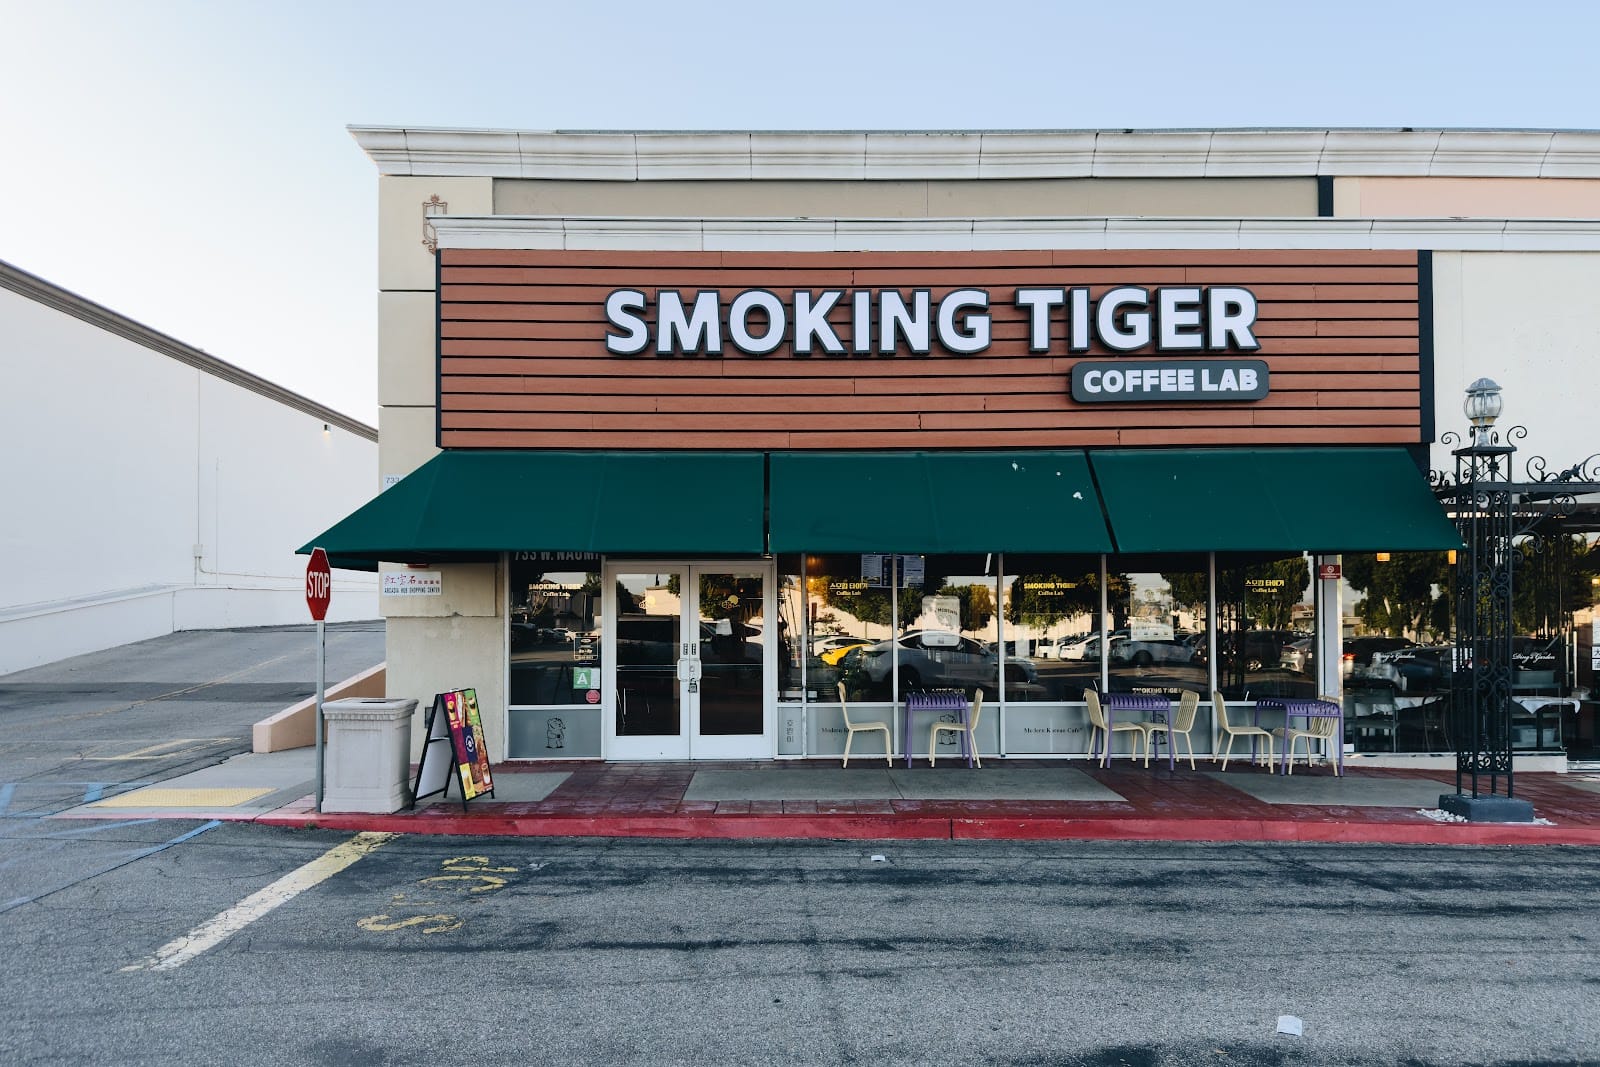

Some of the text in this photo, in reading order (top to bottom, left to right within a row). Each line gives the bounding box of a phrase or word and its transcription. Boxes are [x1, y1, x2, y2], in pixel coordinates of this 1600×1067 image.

[605, 285, 1261, 356] SMOKING TIGER
[1083, 367, 1259, 394] COFFEE LAB
[307, 570, 330, 599] STOP
[576, 672, 589, 685] A
